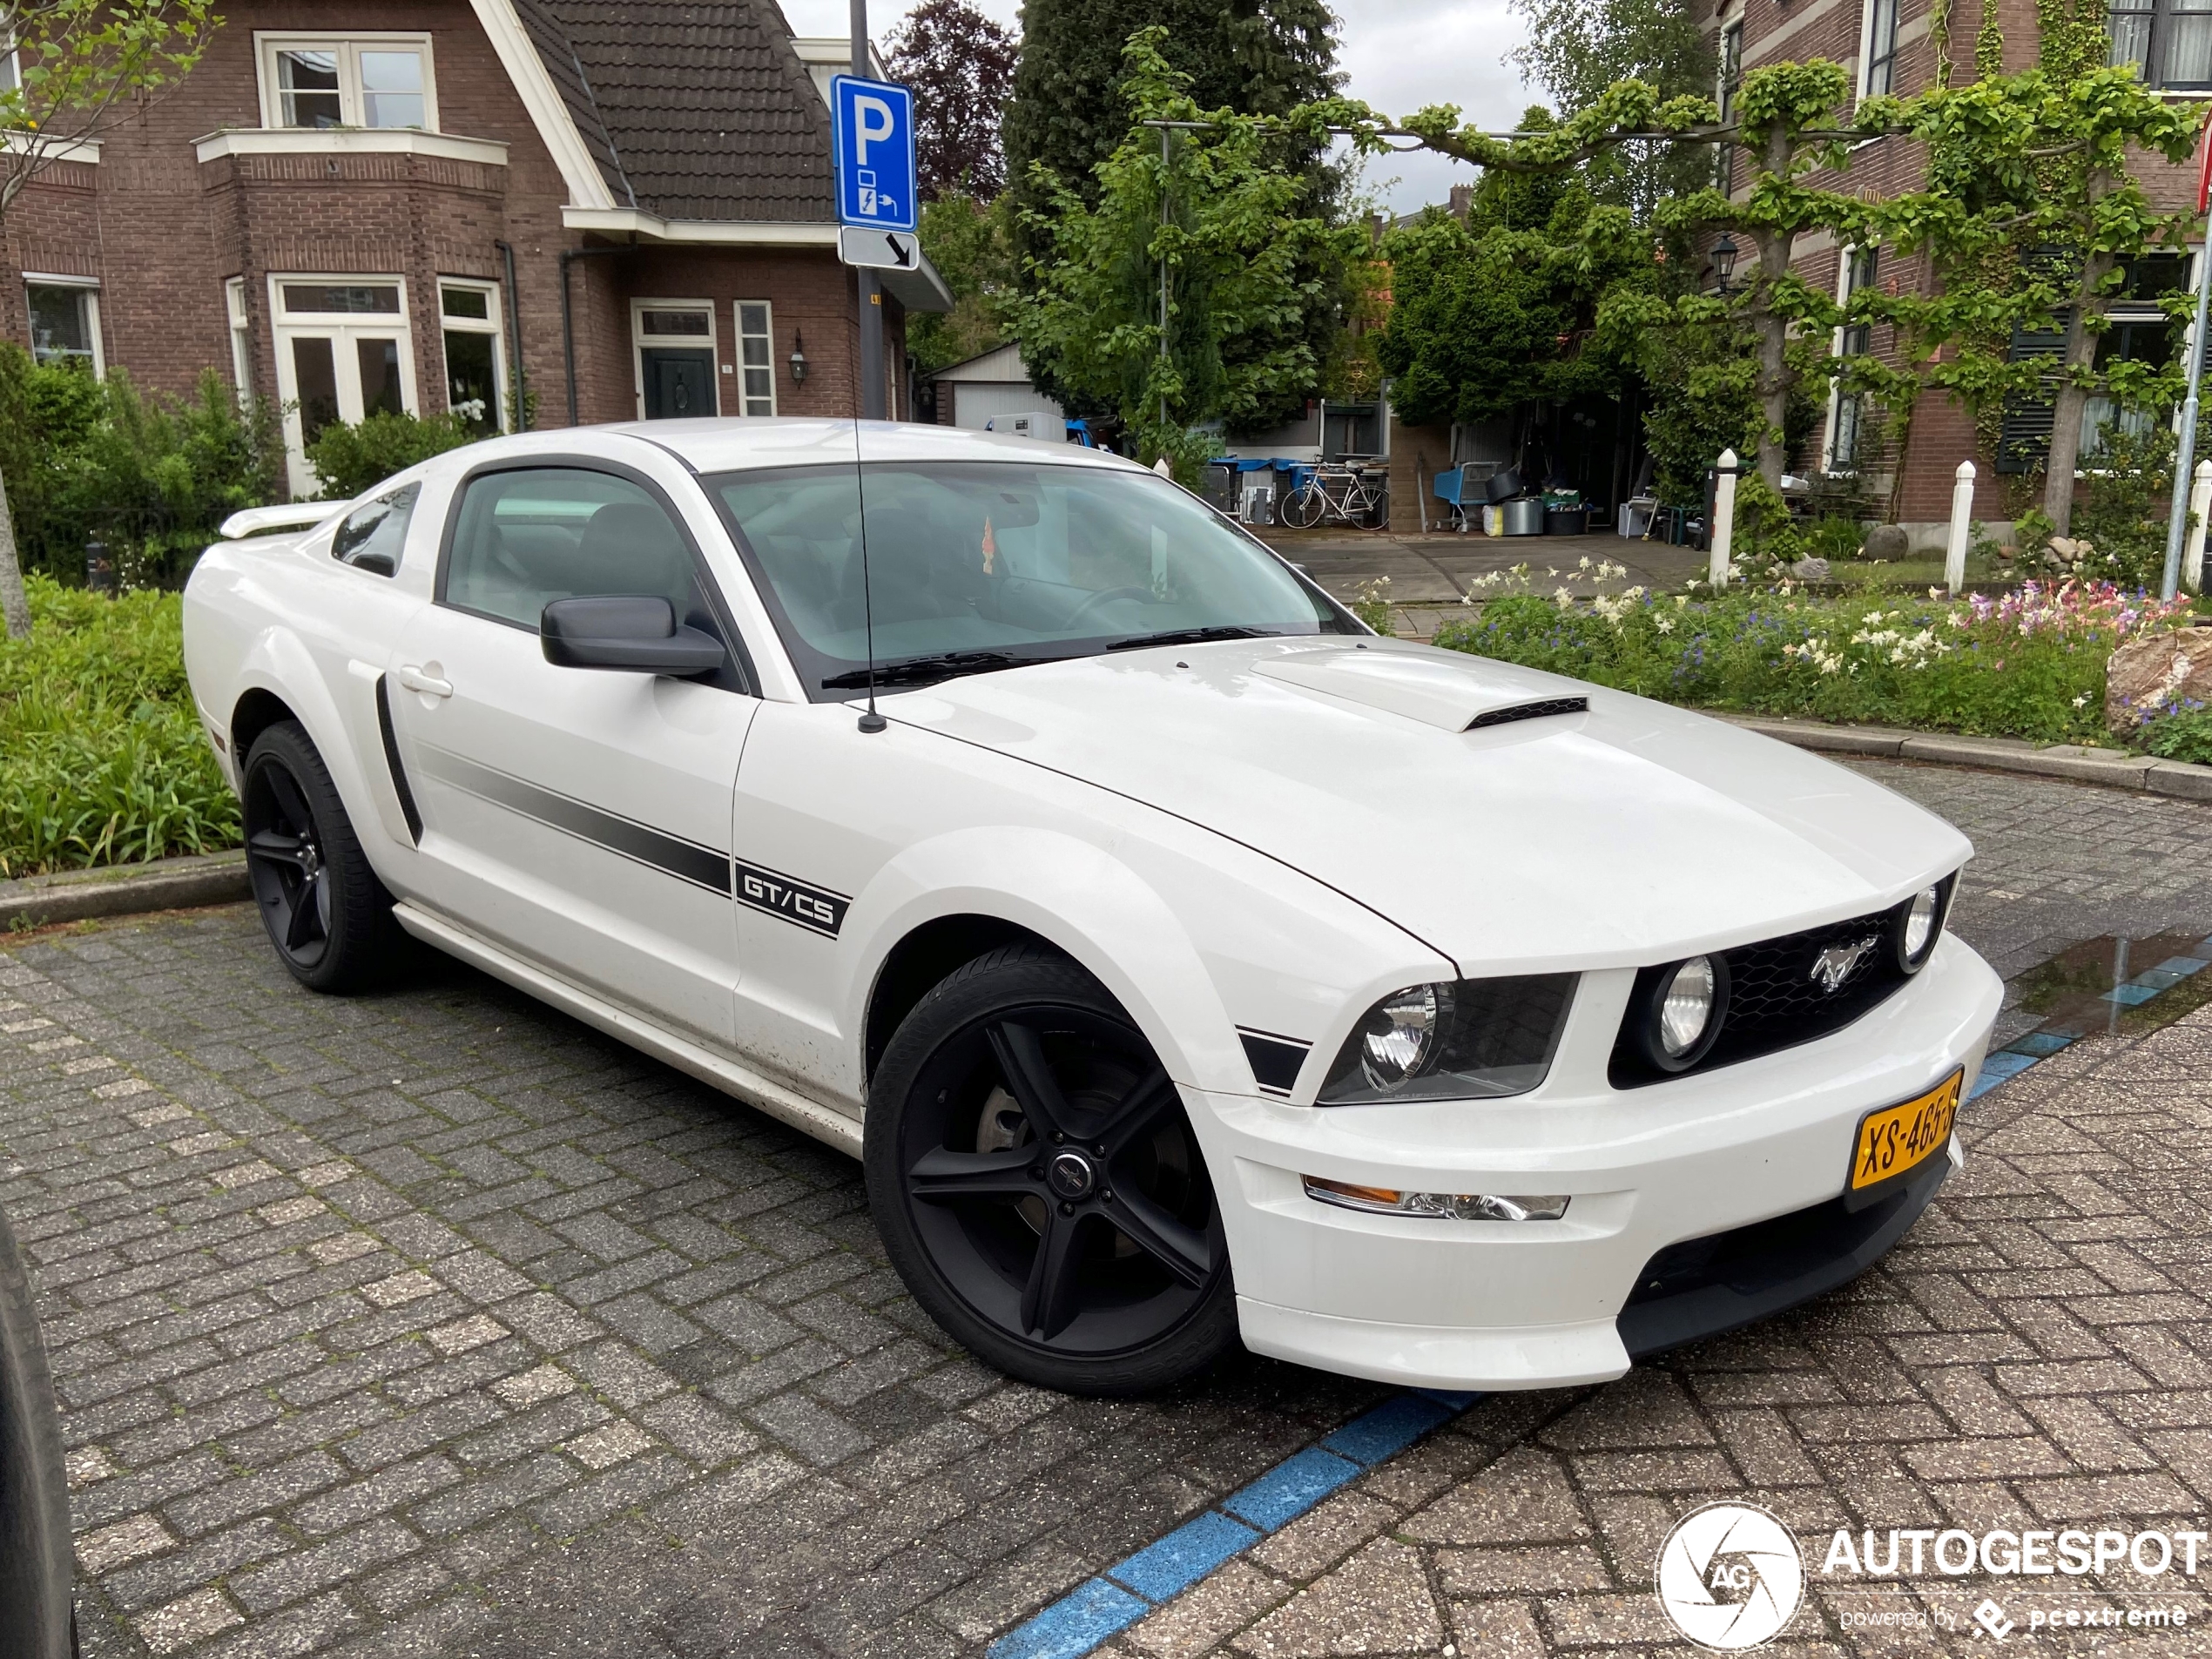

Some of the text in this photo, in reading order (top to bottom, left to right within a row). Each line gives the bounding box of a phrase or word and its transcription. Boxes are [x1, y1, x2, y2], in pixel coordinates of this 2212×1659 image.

[854, 94, 894, 165] P
[744, 874, 833, 925] GT/CS
[1861, 1084, 1957, 1177] XS-465-S
